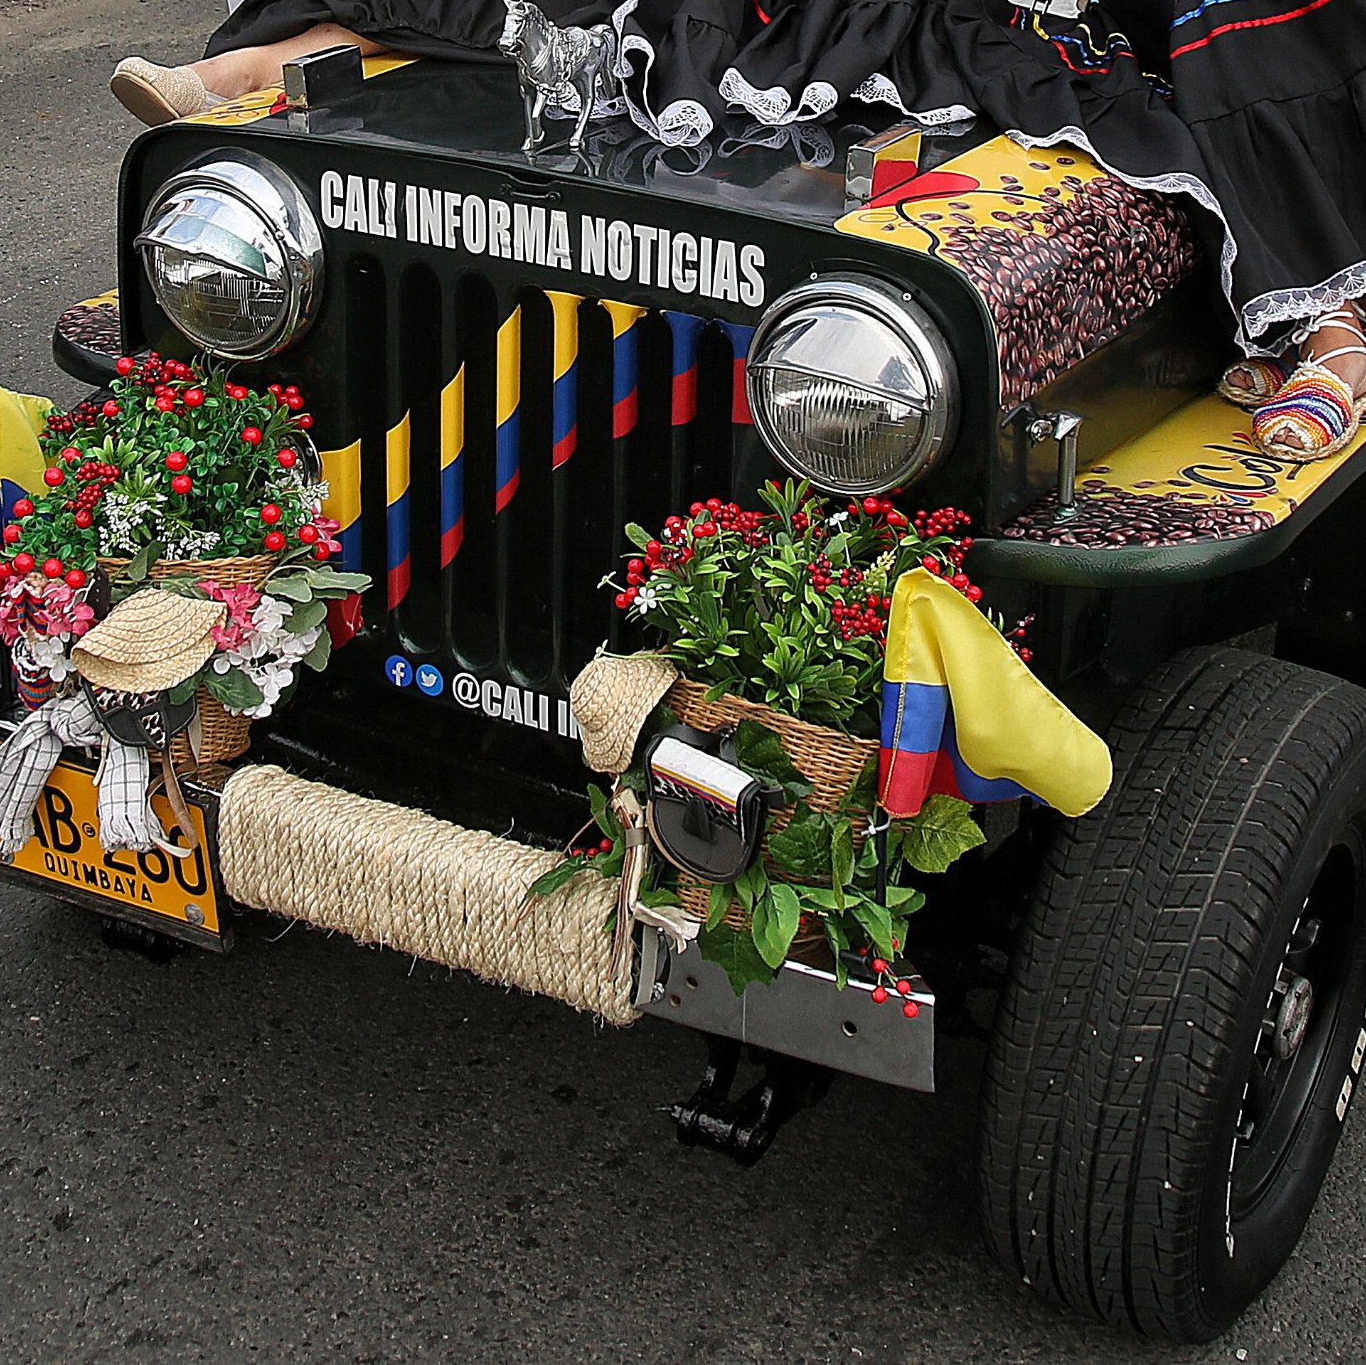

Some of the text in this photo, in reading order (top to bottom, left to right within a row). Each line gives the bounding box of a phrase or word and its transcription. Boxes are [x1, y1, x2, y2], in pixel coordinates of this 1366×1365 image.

[320, 170, 766, 308] CALI INFORMA NOTICIAS
[452, 672, 549, 732] @CALI
[44, 853, 154, 903] QUIMBAYA
